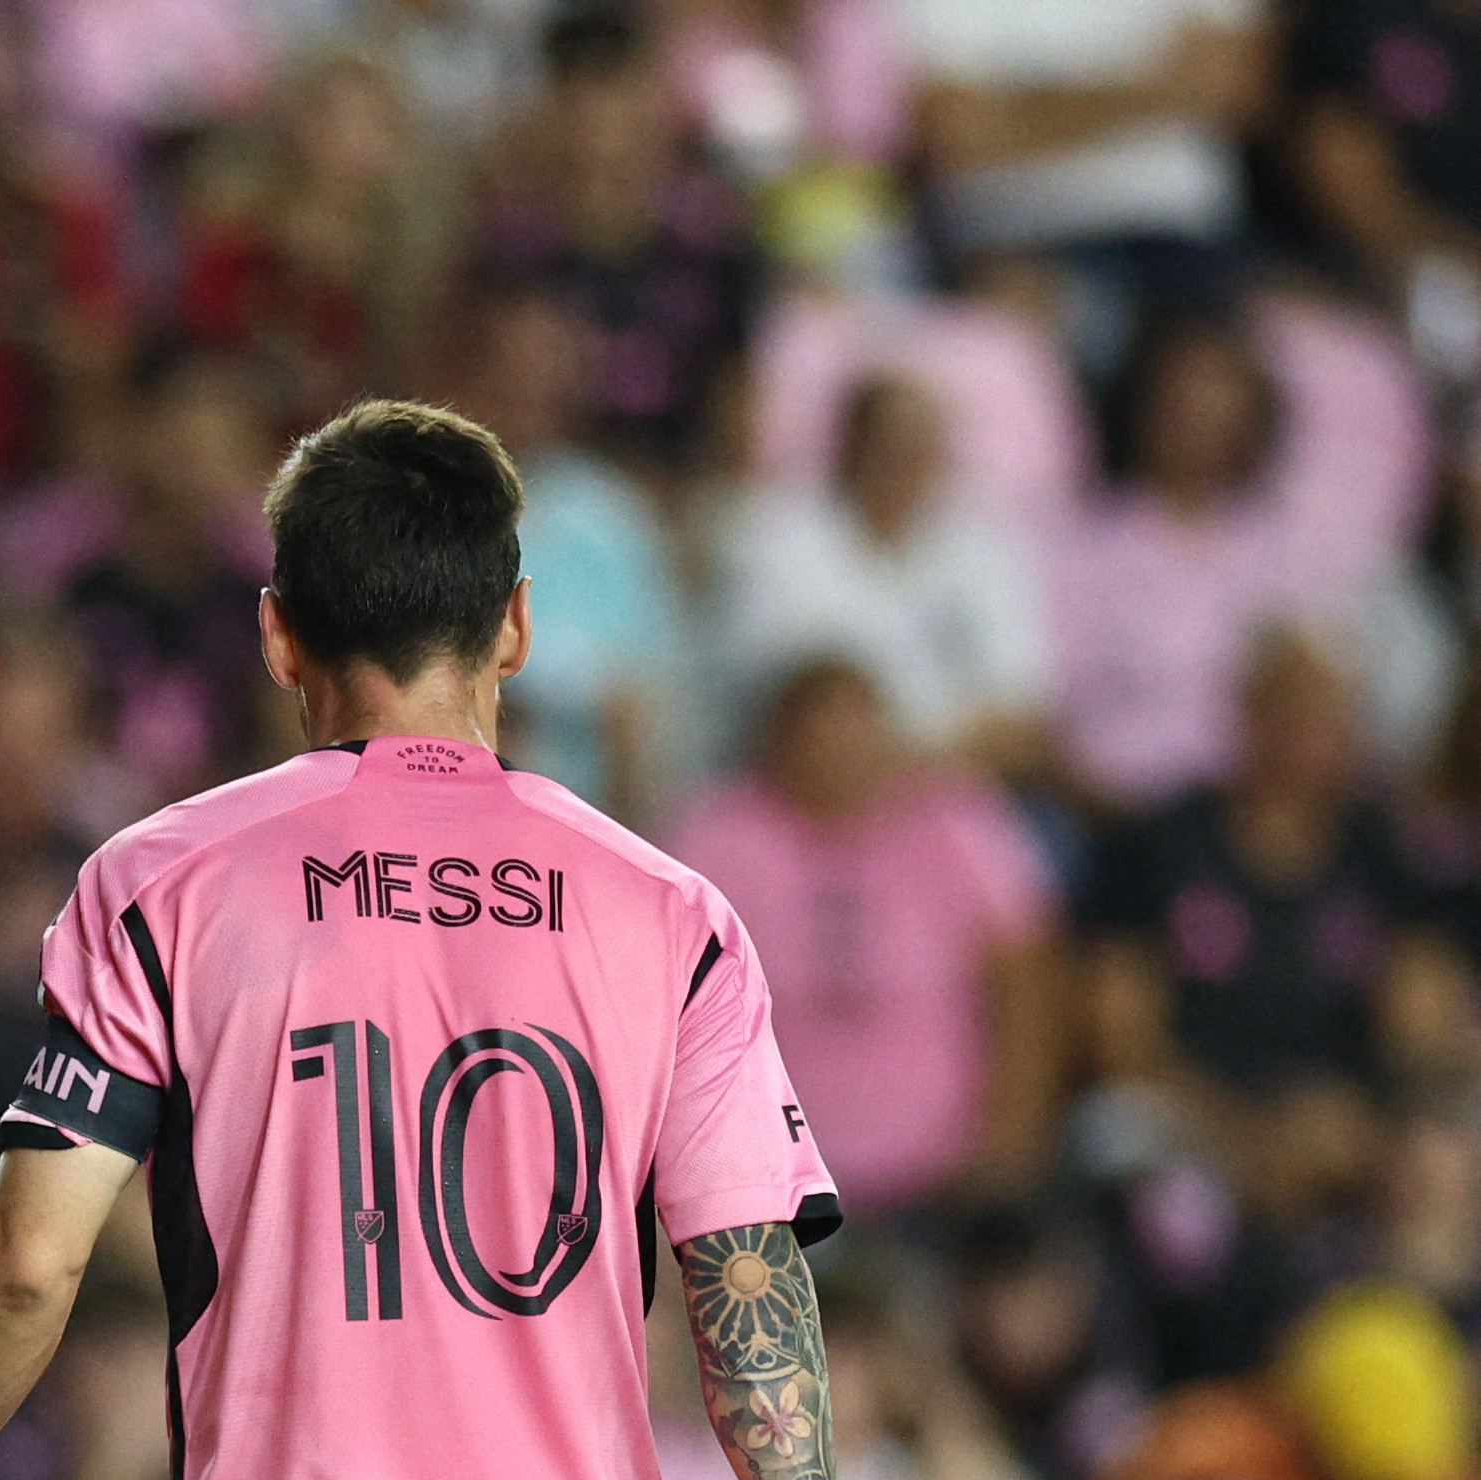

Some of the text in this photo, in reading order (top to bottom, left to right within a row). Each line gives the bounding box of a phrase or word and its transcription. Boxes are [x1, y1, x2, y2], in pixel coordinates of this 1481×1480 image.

[397, 744, 465, 763] FREEDOM
[407, 763, 458, 774] DREAM
[302, 850, 564, 933] MESSI
[290, 1019, 604, 1321] 10
